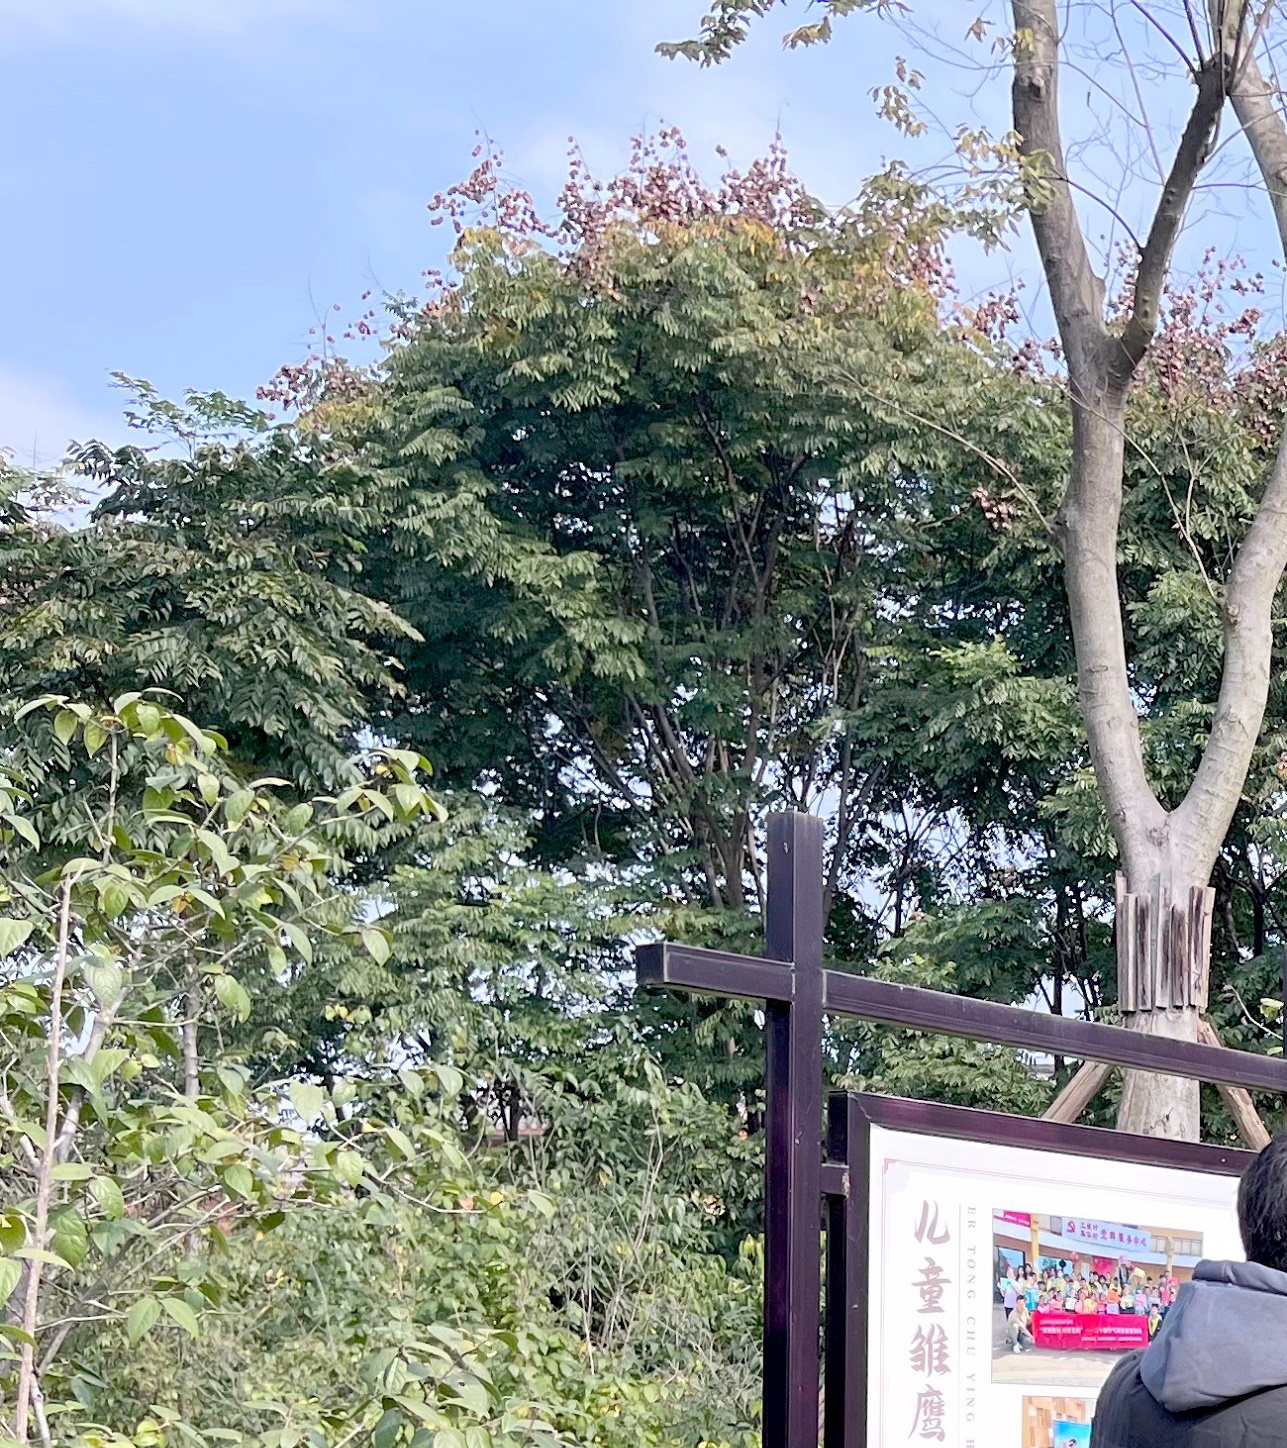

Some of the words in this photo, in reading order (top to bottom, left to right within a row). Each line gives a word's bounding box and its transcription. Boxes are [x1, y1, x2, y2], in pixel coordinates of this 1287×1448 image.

[966, 1245, 976, 1300] TONG
[966, 1316, 976, 1357] CHU
[965, 1373, 976, 1423] YING
